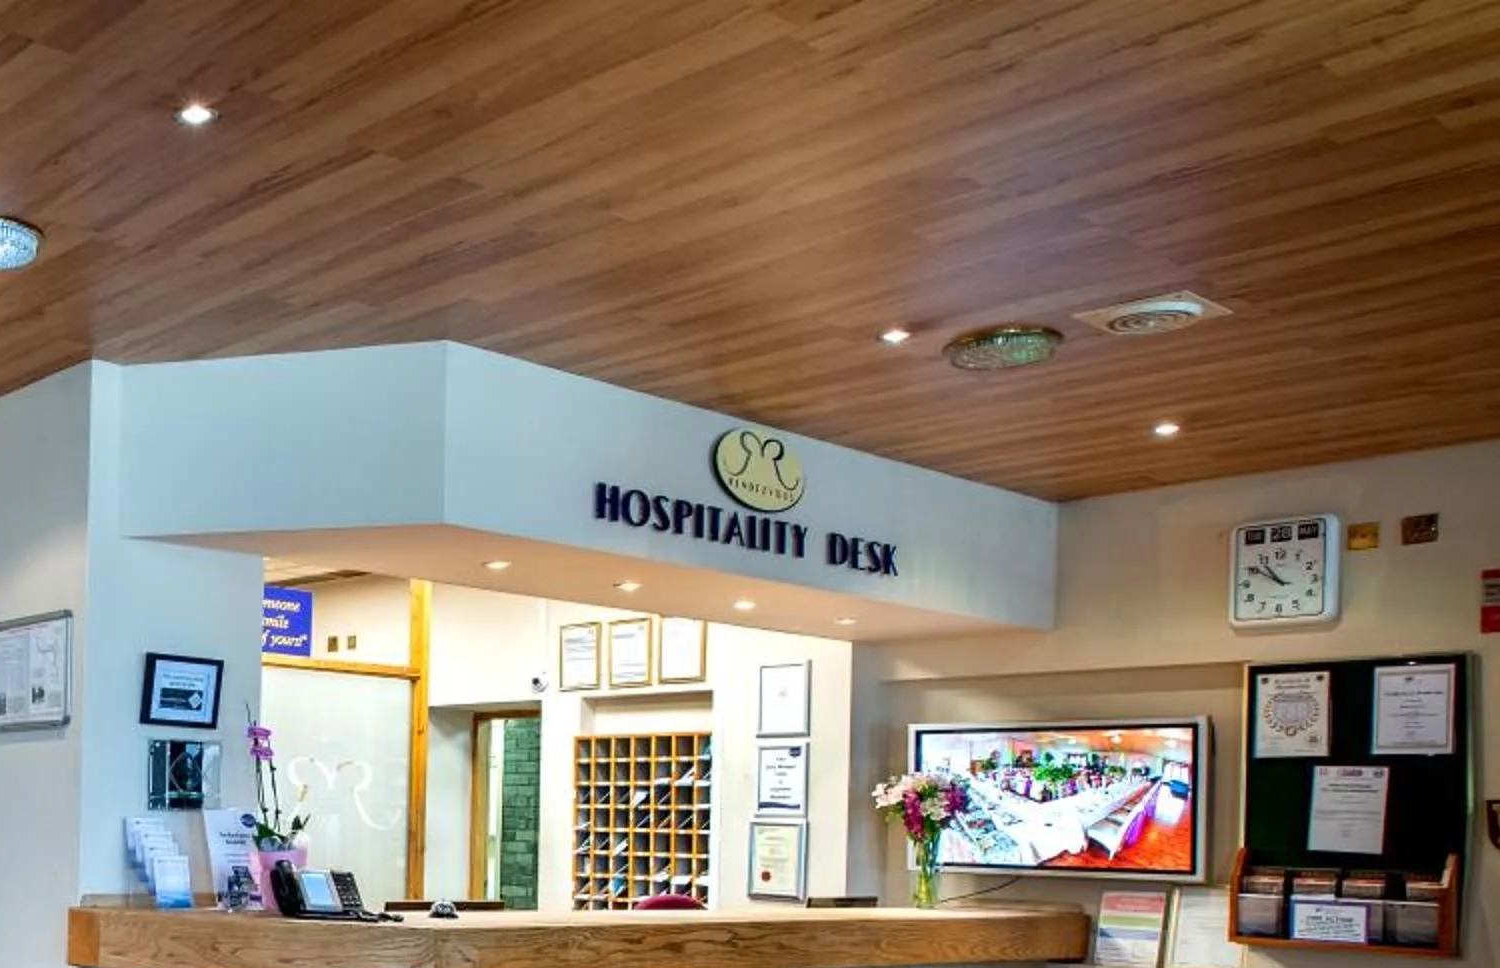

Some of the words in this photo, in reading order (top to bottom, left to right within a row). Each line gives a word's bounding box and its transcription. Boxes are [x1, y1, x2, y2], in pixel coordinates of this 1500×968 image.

[594, 481, 809, 558] HOSPITALITY
[826, 532, 899, 577] DESK
[262, 615, 289, 628] mile
